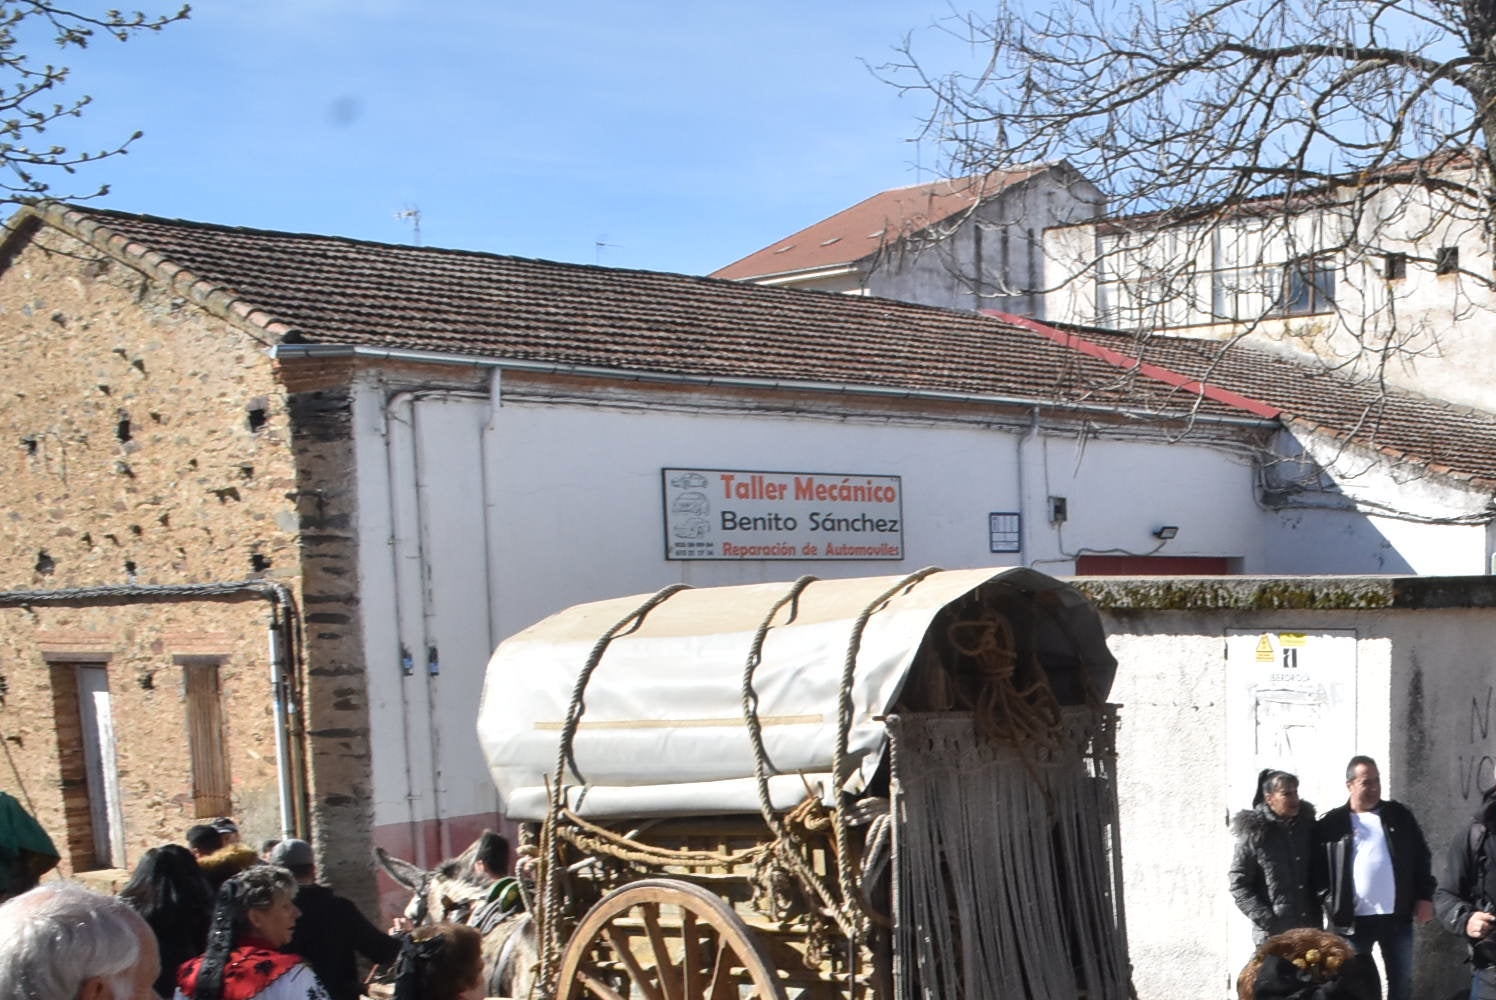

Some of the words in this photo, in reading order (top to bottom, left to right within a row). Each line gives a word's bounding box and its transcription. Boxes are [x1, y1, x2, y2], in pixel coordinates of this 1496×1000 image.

[720, 474, 788, 501] Taller
[794, 476, 897, 503] Mecánico
[720, 510, 798, 532] Benito
[808, 511, 900, 533] Sánchez
[722, 541, 796, 559] Reparación
[802, 542, 818, 556] de
